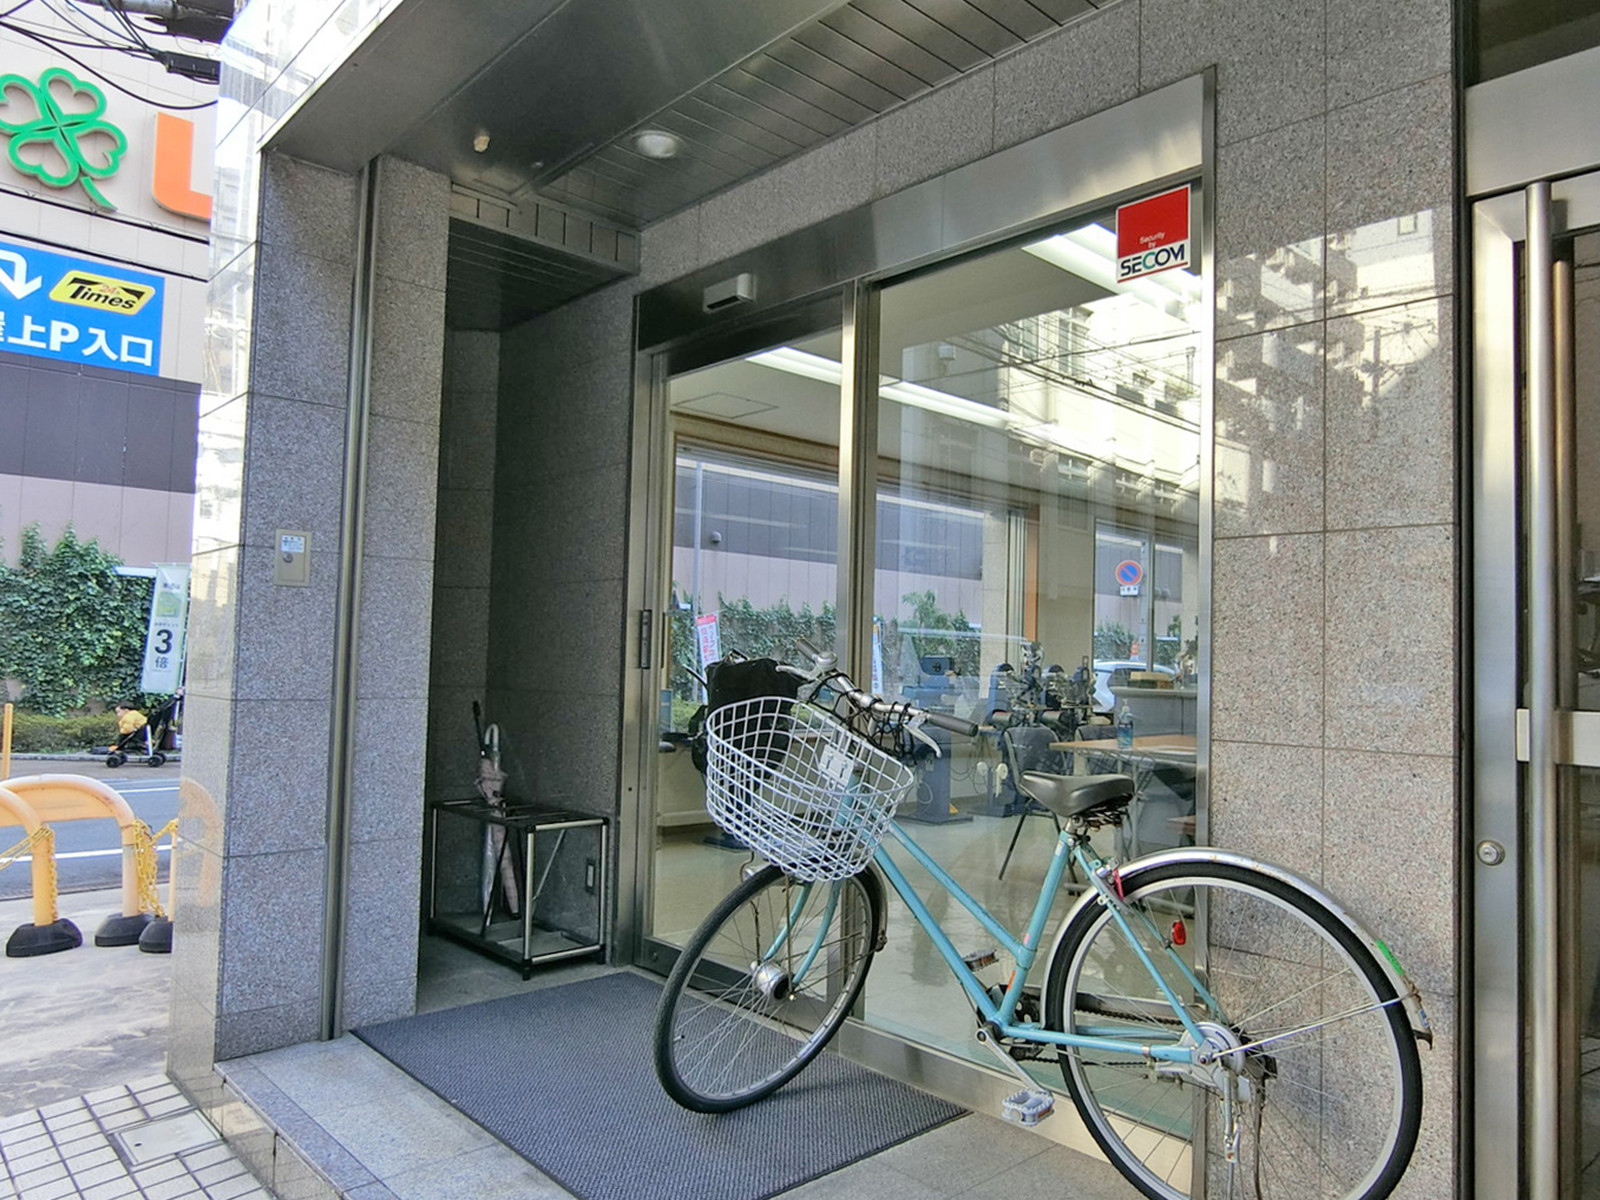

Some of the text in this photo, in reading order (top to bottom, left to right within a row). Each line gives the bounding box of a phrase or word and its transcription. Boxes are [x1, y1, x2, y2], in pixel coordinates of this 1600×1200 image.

[1139, 232, 1165, 244] Security
[1121, 243, 1184, 276] SECOM
[67, 277, 140, 310] Times
[0, 311, 153, 367] 上P入口
